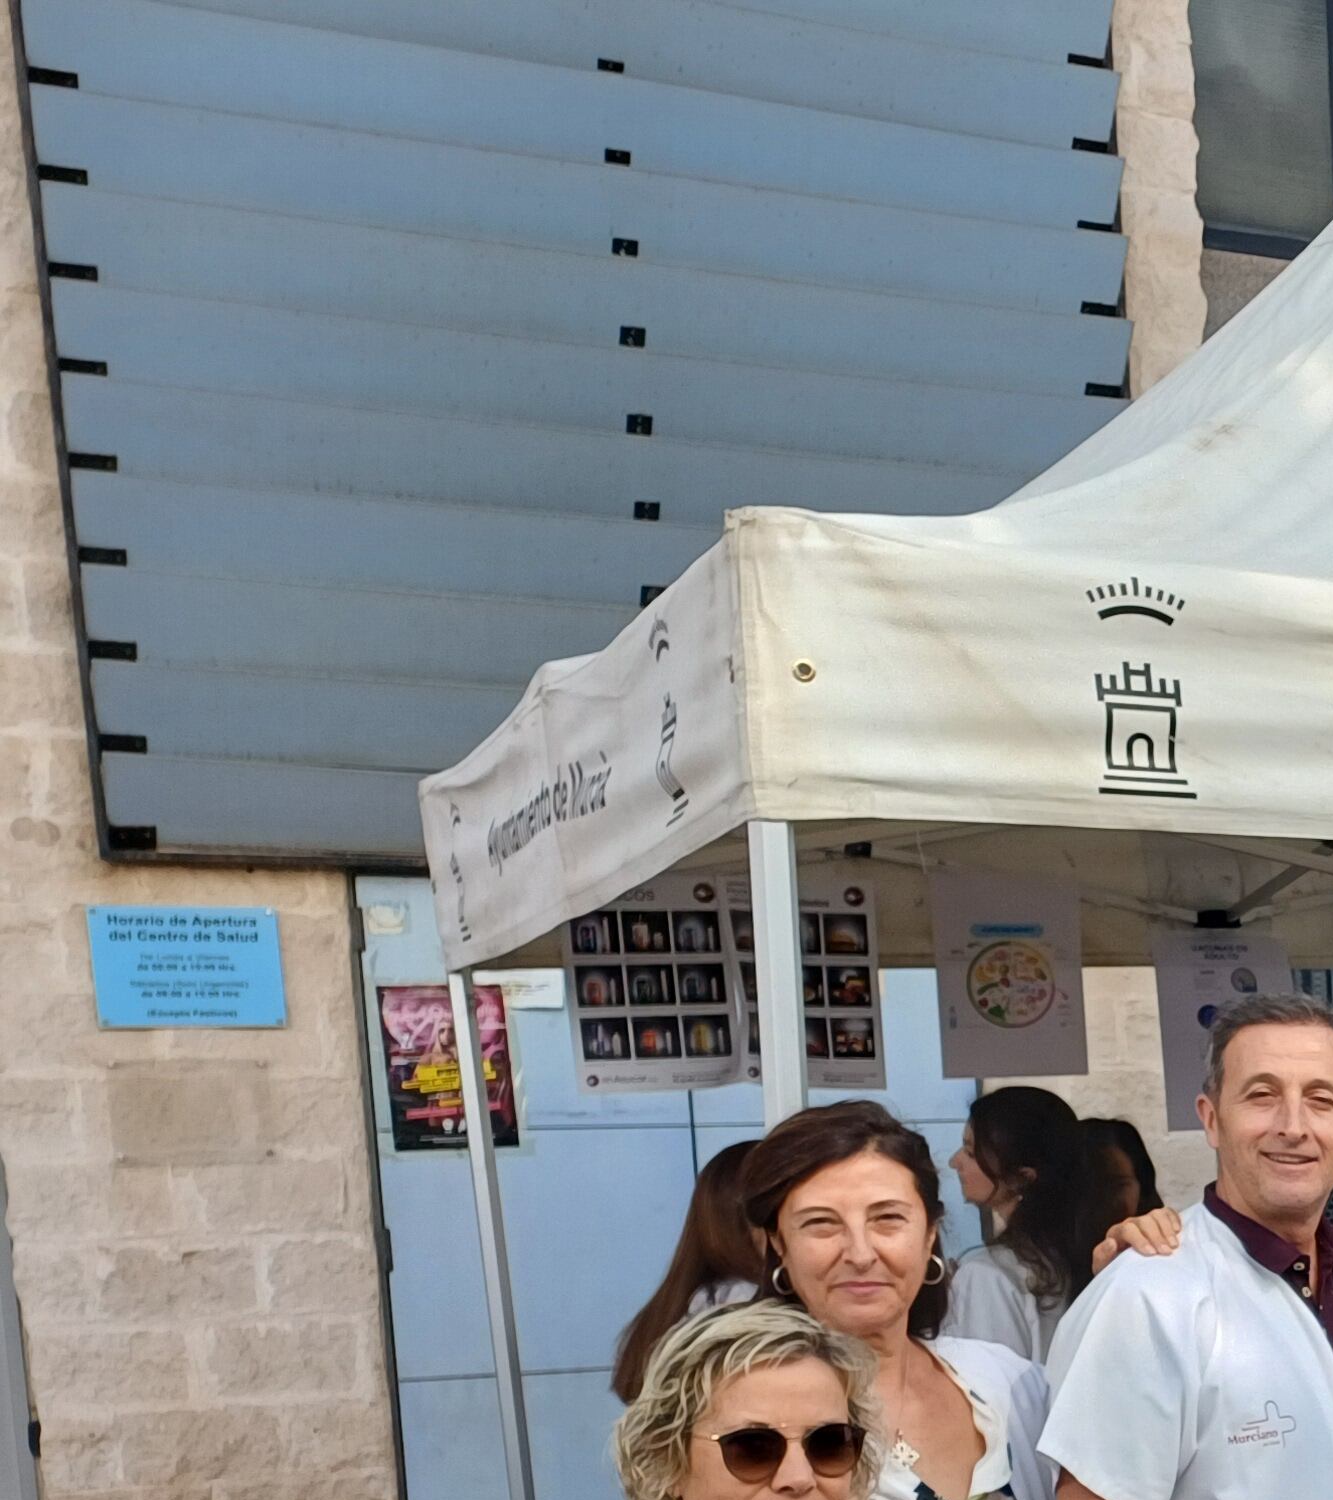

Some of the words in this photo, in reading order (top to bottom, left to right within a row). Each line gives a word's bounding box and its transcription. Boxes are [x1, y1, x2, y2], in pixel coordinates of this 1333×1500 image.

[487, 780, 551, 877] Ayuntamiento
[553, 765, 567, 822] de
[106, 914, 165, 927] Horario
[169, 915, 188, 927] de
[191, 915, 258, 929] Apertura
[108, 930, 132, 942] del
[137, 930, 189, 942] Centro
[193, 931, 212, 942] de
[216, 931, 259, 943] Salud
